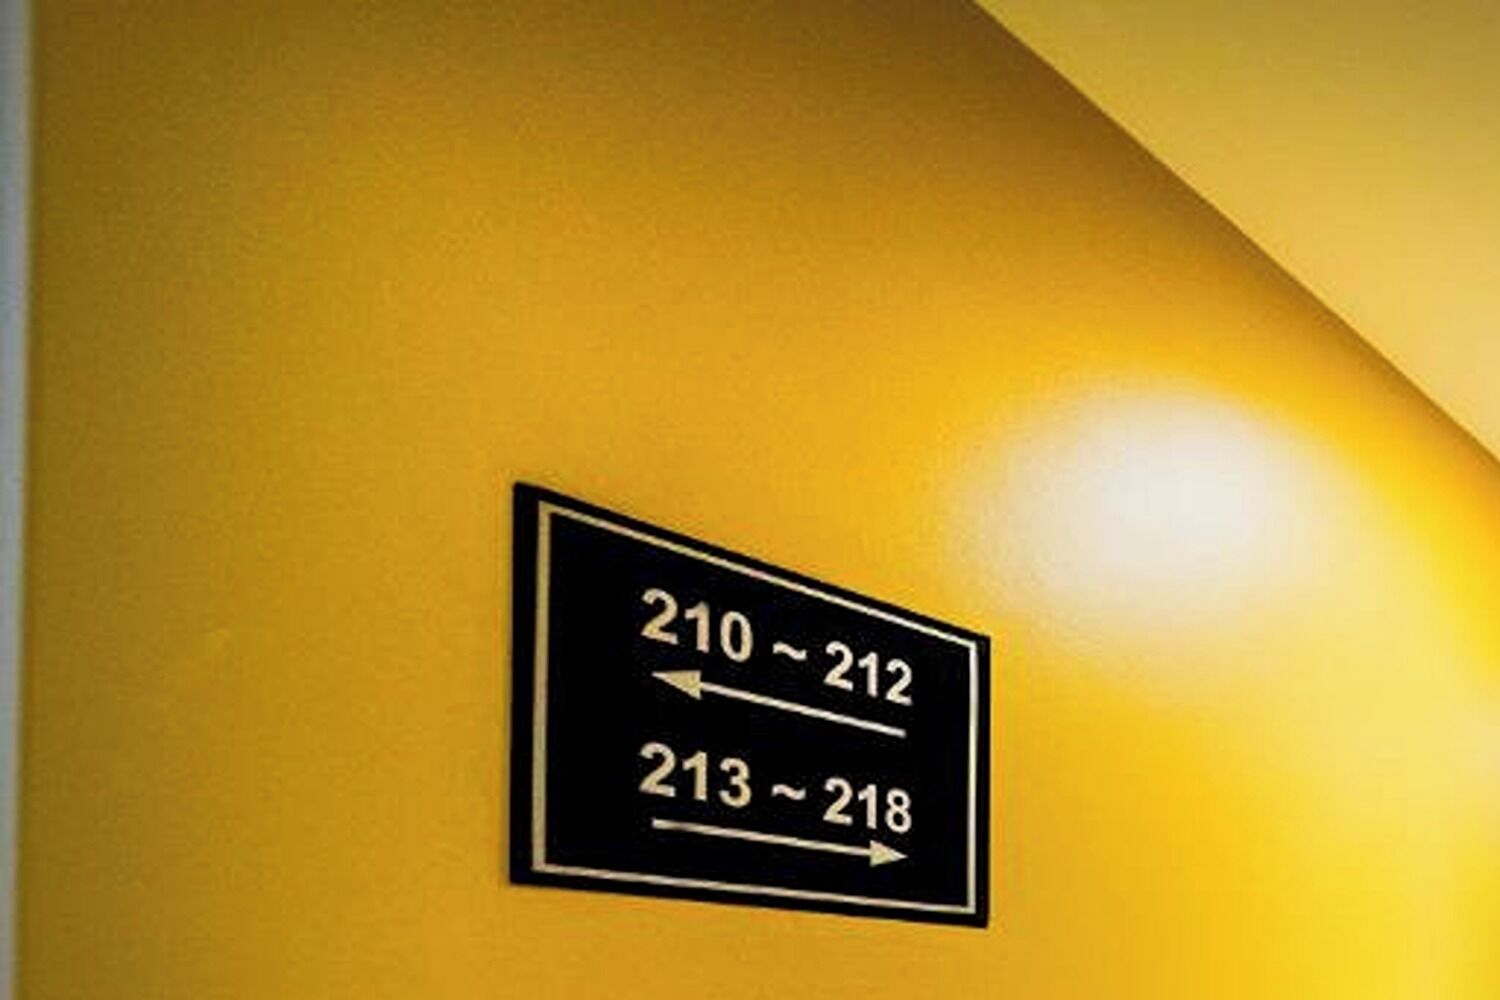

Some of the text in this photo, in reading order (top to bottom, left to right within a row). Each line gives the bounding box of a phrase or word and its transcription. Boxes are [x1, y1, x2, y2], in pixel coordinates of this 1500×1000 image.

[641, 588, 753, 662] 210
[823, 641, 912, 706] 212
[640, 742, 752, 808] 213
[823, 777, 912, 834] 218
